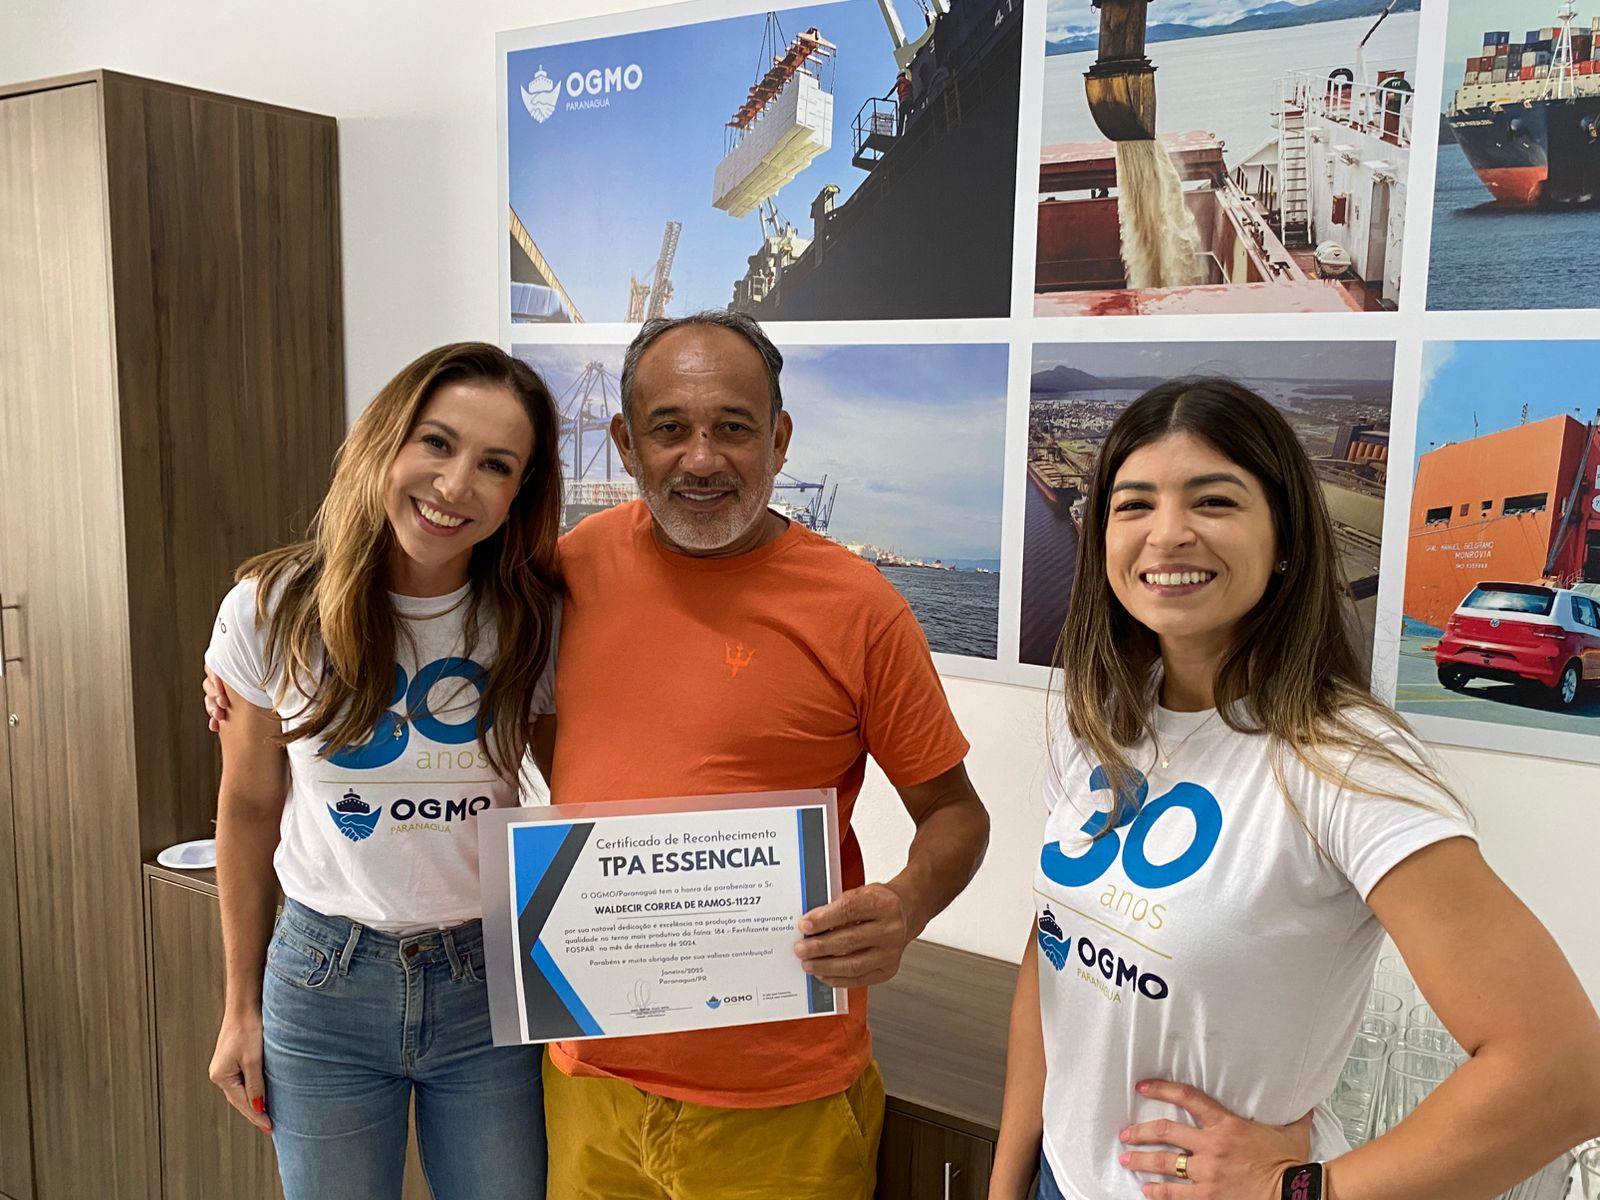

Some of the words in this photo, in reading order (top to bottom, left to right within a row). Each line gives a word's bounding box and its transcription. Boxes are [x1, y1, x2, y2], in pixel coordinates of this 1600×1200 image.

[566, 63, 643, 97] OGMO
[1455, 550, 1492, 559] MONROVIA
[416, 750, 490, 770] anos
[390, 796, 491, 822] OGMO
[1040, 763, 1223, 889] 30
[596, 835, 661, 850] Certificado
[664, 834, 679, 846] de
[683, 829, 777, 844] Reconhecimento
[599, 855, 646, 877] TPA
[652, 846, 781, 874] ESSENCIAL
[714, 883, 756, 892] parabenizar
[594, 904, 642, 915] WALDECIR
[644, 901, 682, 911] CORREA
[684, 900, 696, 909] DE
[697, 896, 761, 908] RAMOS-11227
[1100, 884, 1167, 930] anos
[591, 924, 616, 932] notável
[617, 923, 651, 931] dedicação
[705, 918, 736, 927] produção
[565, 936, 598, 945] qualidade
[648, 931, 680, 940] produtivo
[731, 926, 769, 934] Fertilizante
[565, 945, 595, 954] FOSPAR
[634, 941, 667, 949] dezembro
[668, 940, 677, 948] de
[589, 959, 620, 967] Parabéns
[1078, 937, 1169, 1000] OGMO
[723, 994, 753, 1004] OGMO
